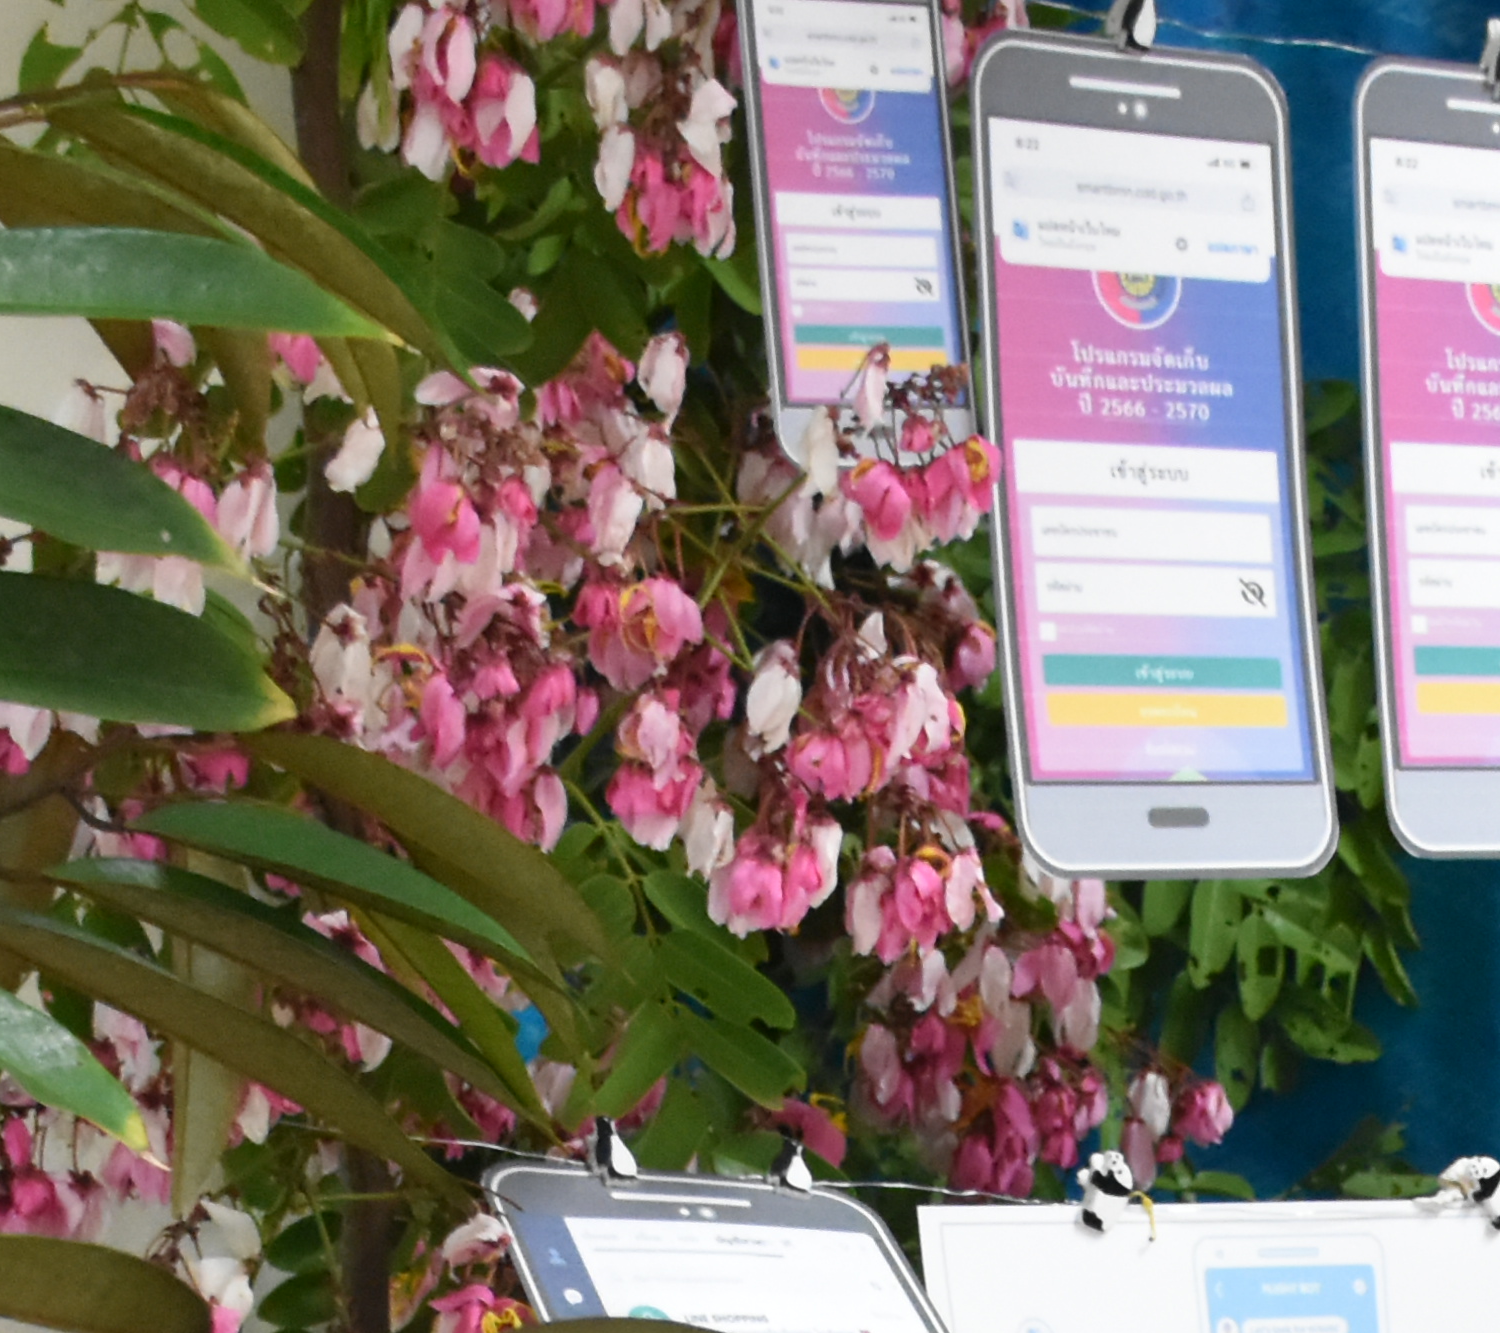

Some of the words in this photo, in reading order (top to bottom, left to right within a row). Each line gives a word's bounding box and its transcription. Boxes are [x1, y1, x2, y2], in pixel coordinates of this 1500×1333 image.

[1069, 339, 1210, 372] โปรแกรมจัดเก็บ
[1049, 364, 1234, 398] บันทึกและประมวลผล
[1078, 392, 1094, 416] ปี
[1100, 396, 1147, 419] 2566
[1165, 401, 1211, 422] 2570
[1452, 396, 1466, 420] ปี
[1109, 457, 1190, 486] เข้าสู่ระบบ
[711, 1314, 770, 1324] SHOPPING
